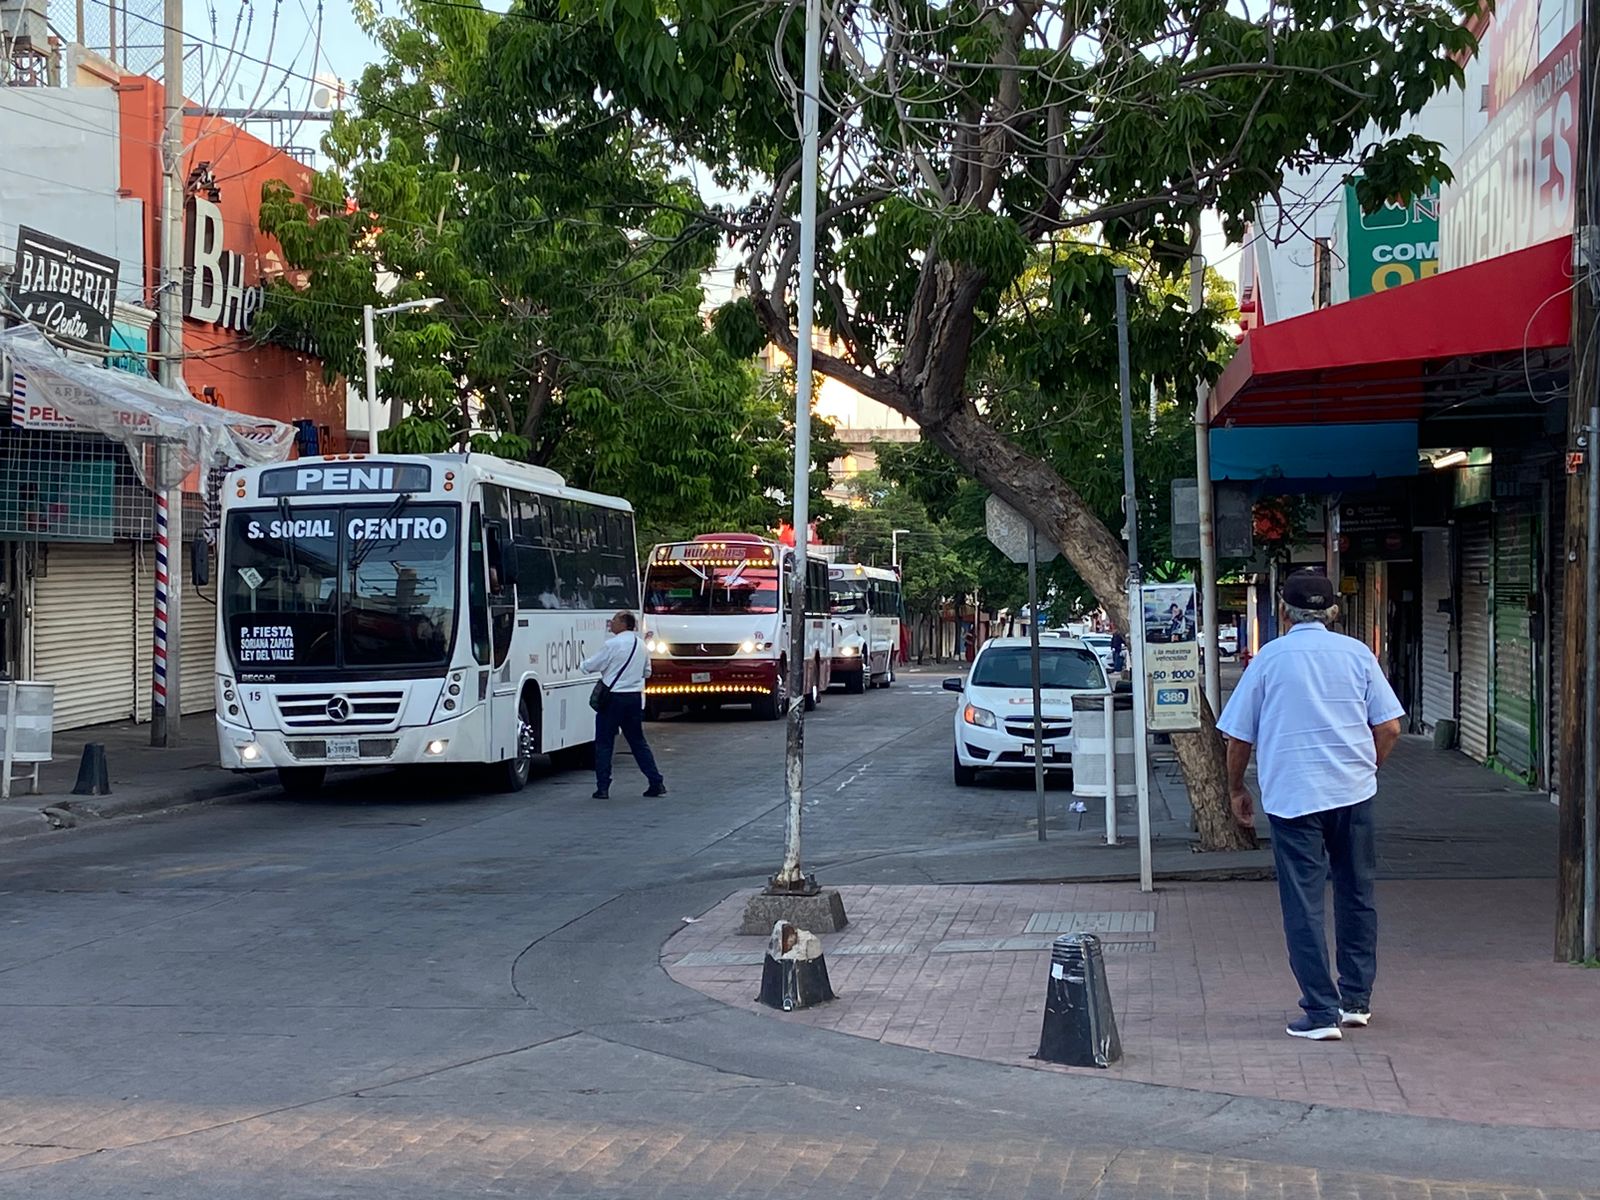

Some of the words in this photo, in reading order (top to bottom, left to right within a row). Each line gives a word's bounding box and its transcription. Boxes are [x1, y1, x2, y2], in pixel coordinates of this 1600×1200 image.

[20, 251, 111, 320] BARBERIA
[44, 302, 88, 338] Centro
[296, 467, 394, 490] PENI
[247, 520, 265, 539] S.
[269, 519, 334, 538] SOCIAL
[348, 517, 448, 540] CENTRO
[241, 626, 250, 639] P.
[253, 626, 293, 638] FIESTA
[241, 638, 269, 650] SORIANA
[270, 638, 294, 649] ZAPATA
[546, 627, 586, 680] redplus
[241, 650, 254, 661] LEY
[256, 650, 270, 661] DEL
[271, 649, 294, 660] VALLE
[249, 691, 261, 701] 15
